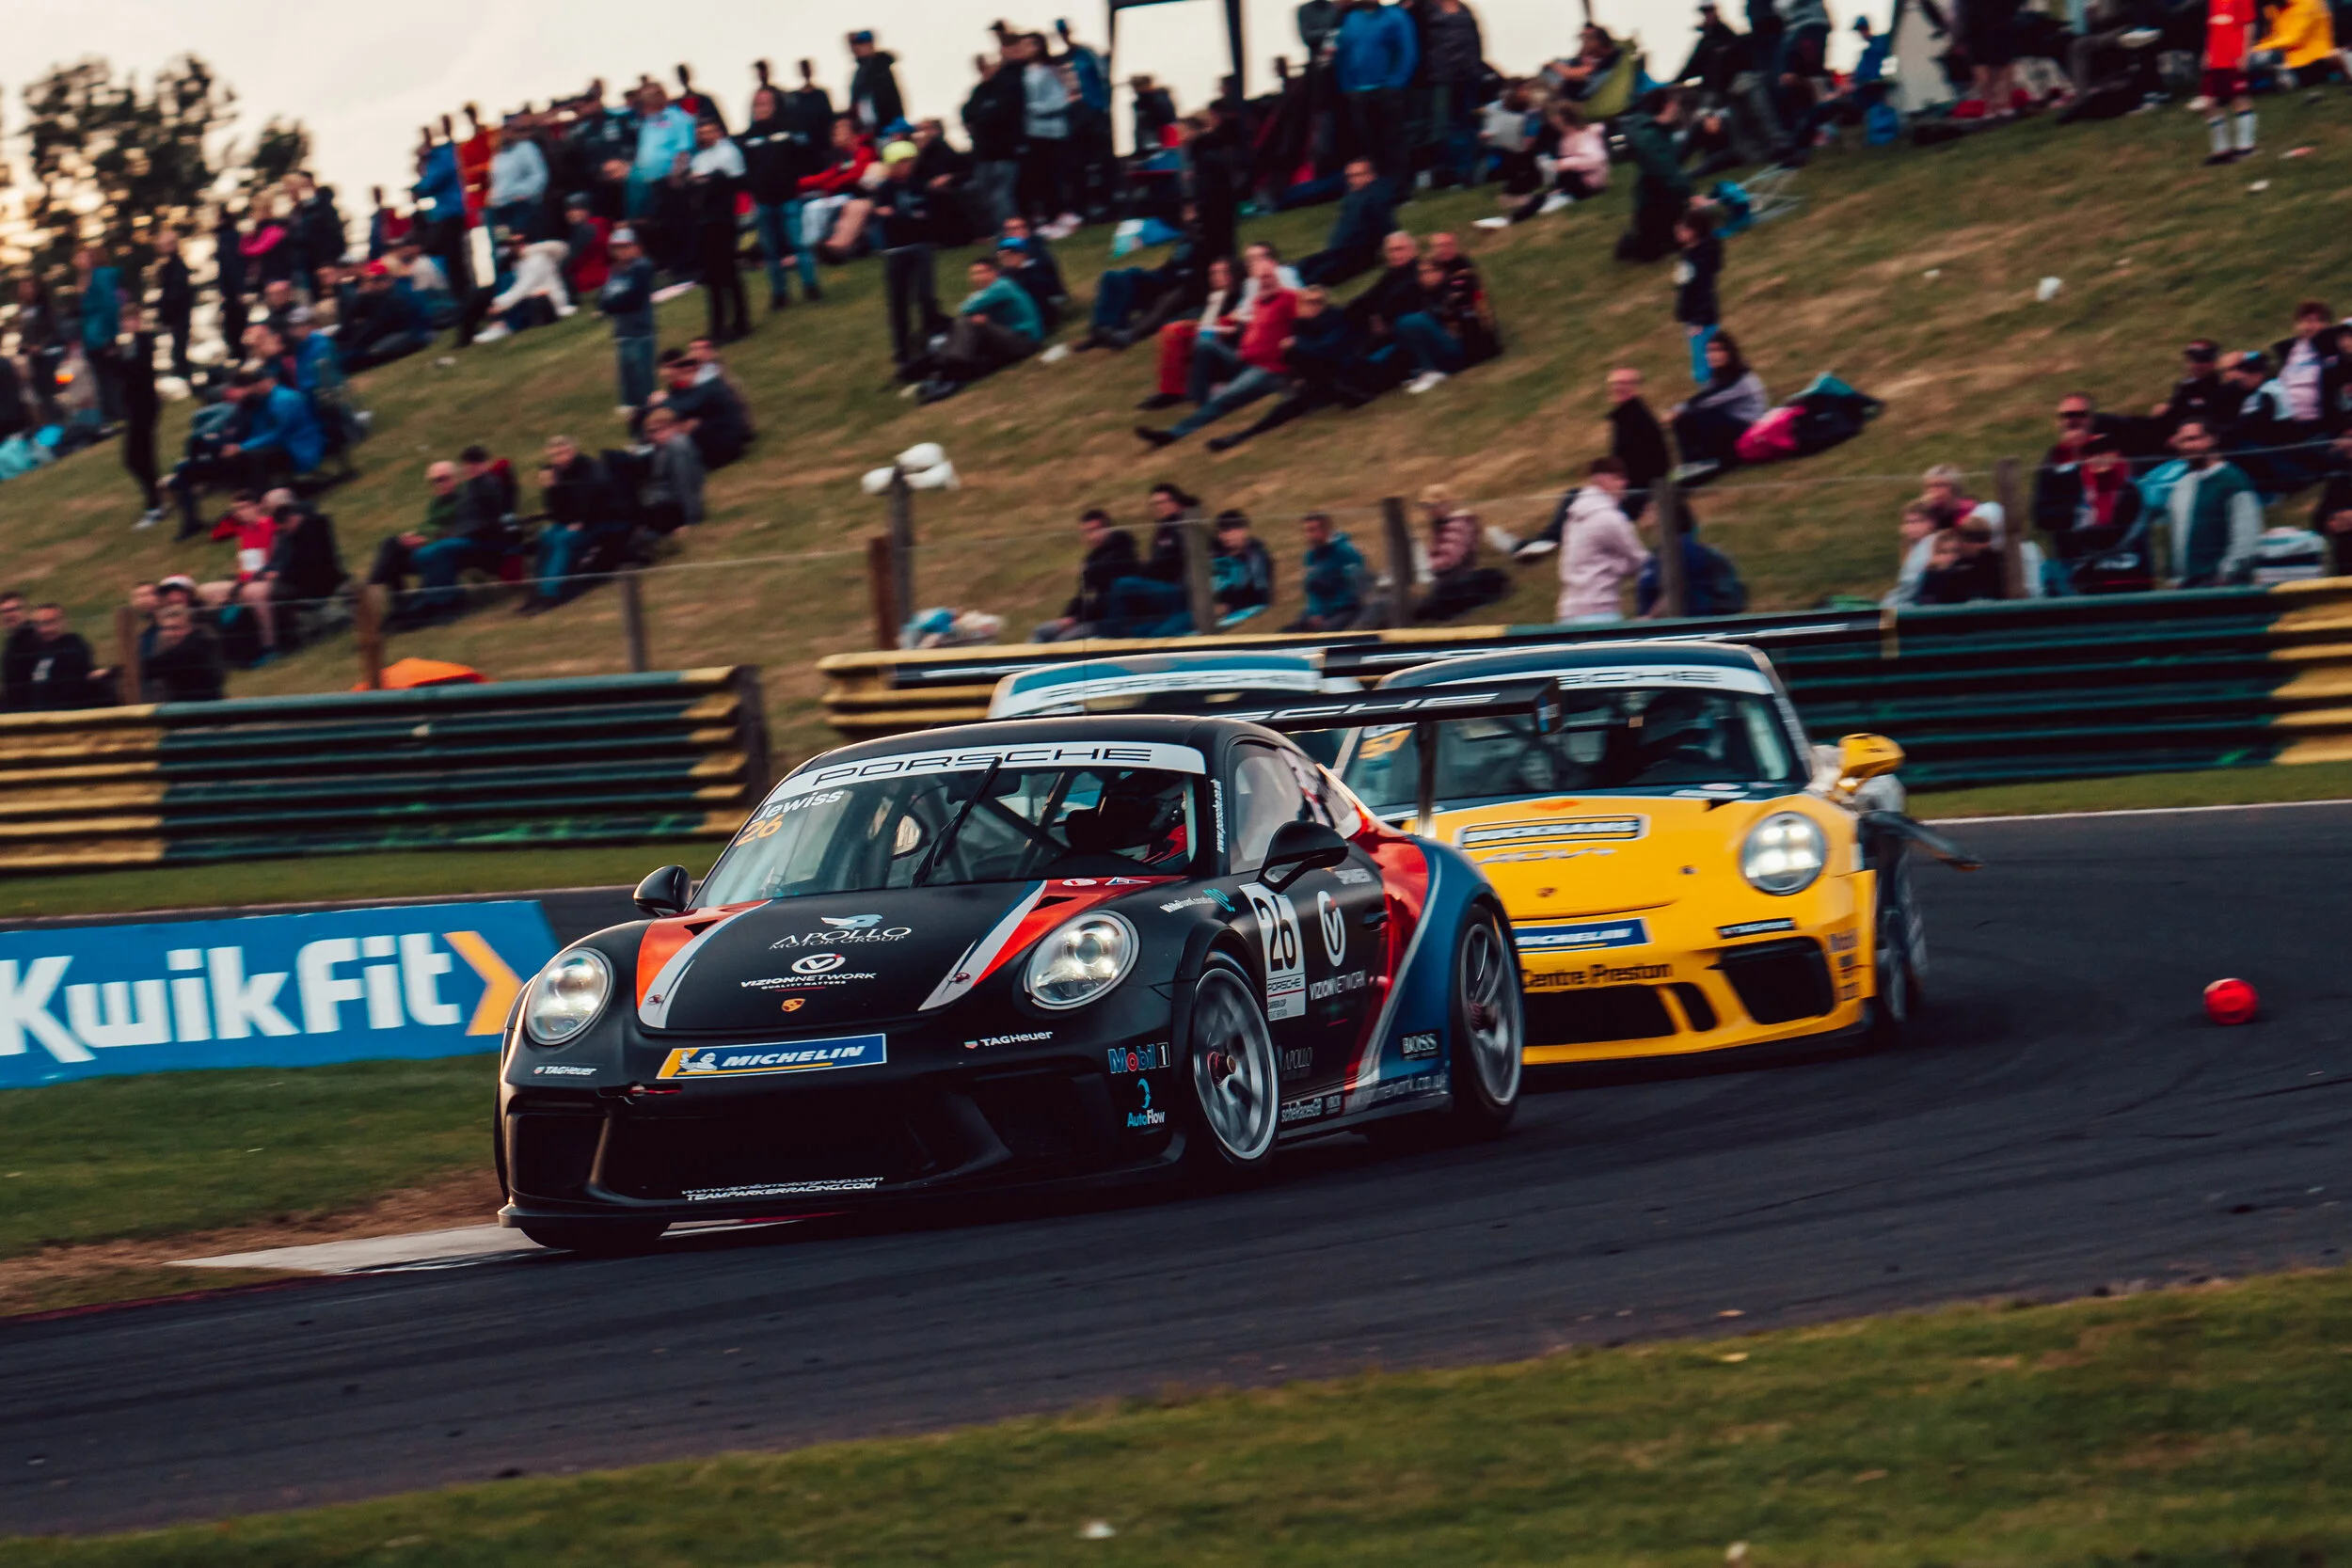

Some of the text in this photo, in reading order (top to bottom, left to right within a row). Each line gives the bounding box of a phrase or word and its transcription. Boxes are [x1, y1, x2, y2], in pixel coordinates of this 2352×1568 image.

[1557, 671, 1724, 686] SCHE
[1209, 692, 1501, 721] SCHE
[813, 748, 1152, 786] PORSCHE
[751, 790, 845, 824] Jewiss
[735, 813, 787, 847] 26
[769, 940, 835, 950] MOTOR
[772, 927, 913, 946] APOLLO
[1252, 895, 1297, 972] 26
[740, 972, 878, 988] VIZIONNETWORK
[722, 1045, 866, 1069] MICHELIN
[1107, 1044, 1156, 1074] Mobil
[686, 1181, 878, 1201] TEAMPARKERRACING.COM
